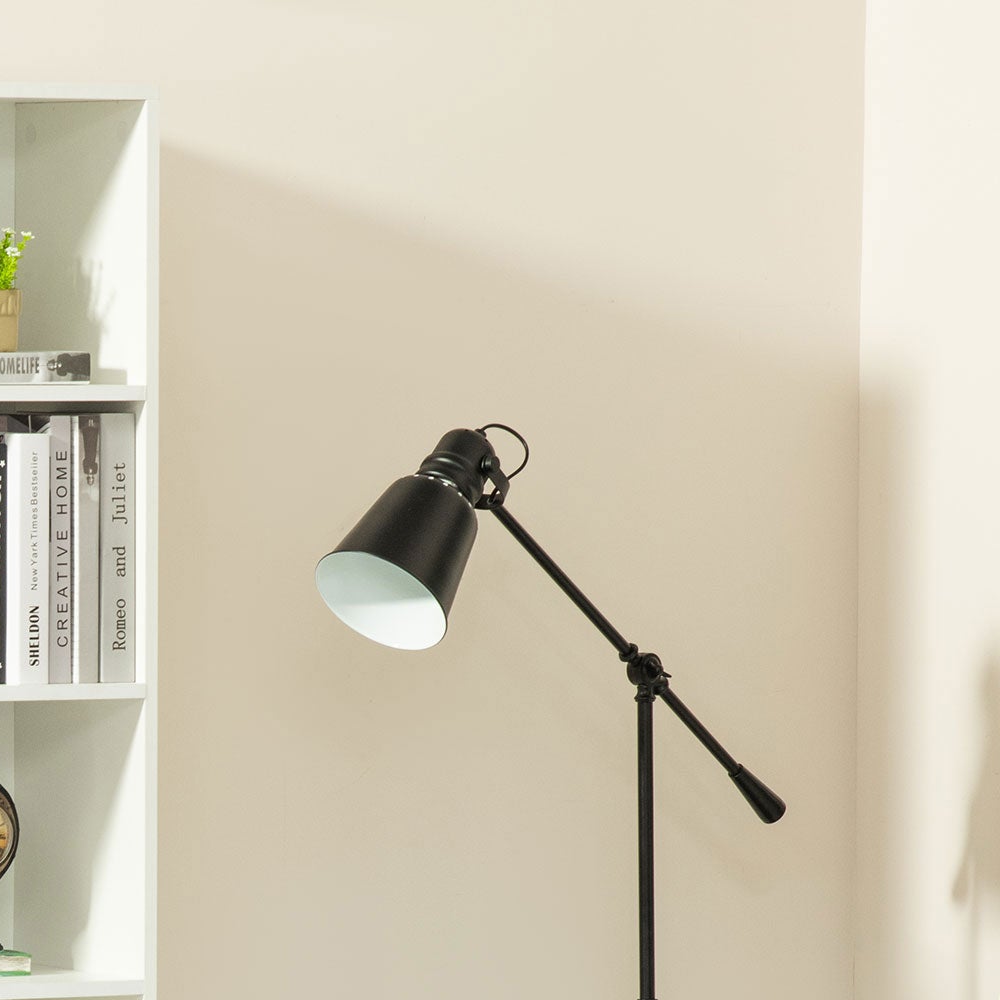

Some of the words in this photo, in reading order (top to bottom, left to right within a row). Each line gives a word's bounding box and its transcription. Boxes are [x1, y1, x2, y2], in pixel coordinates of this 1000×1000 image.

[55, 450, 68, 515] HOME
[111, 462, 128, 524] Juliet
[30, 508, 39, 539] Times
[30, 568, 39, 590] New
[56, 530, 68, 648] CREATIVE
[112, 545, 126, 577] and
[28, 605, 41, 667] SHELDON
[112, 598, 127, 651] Romeo
